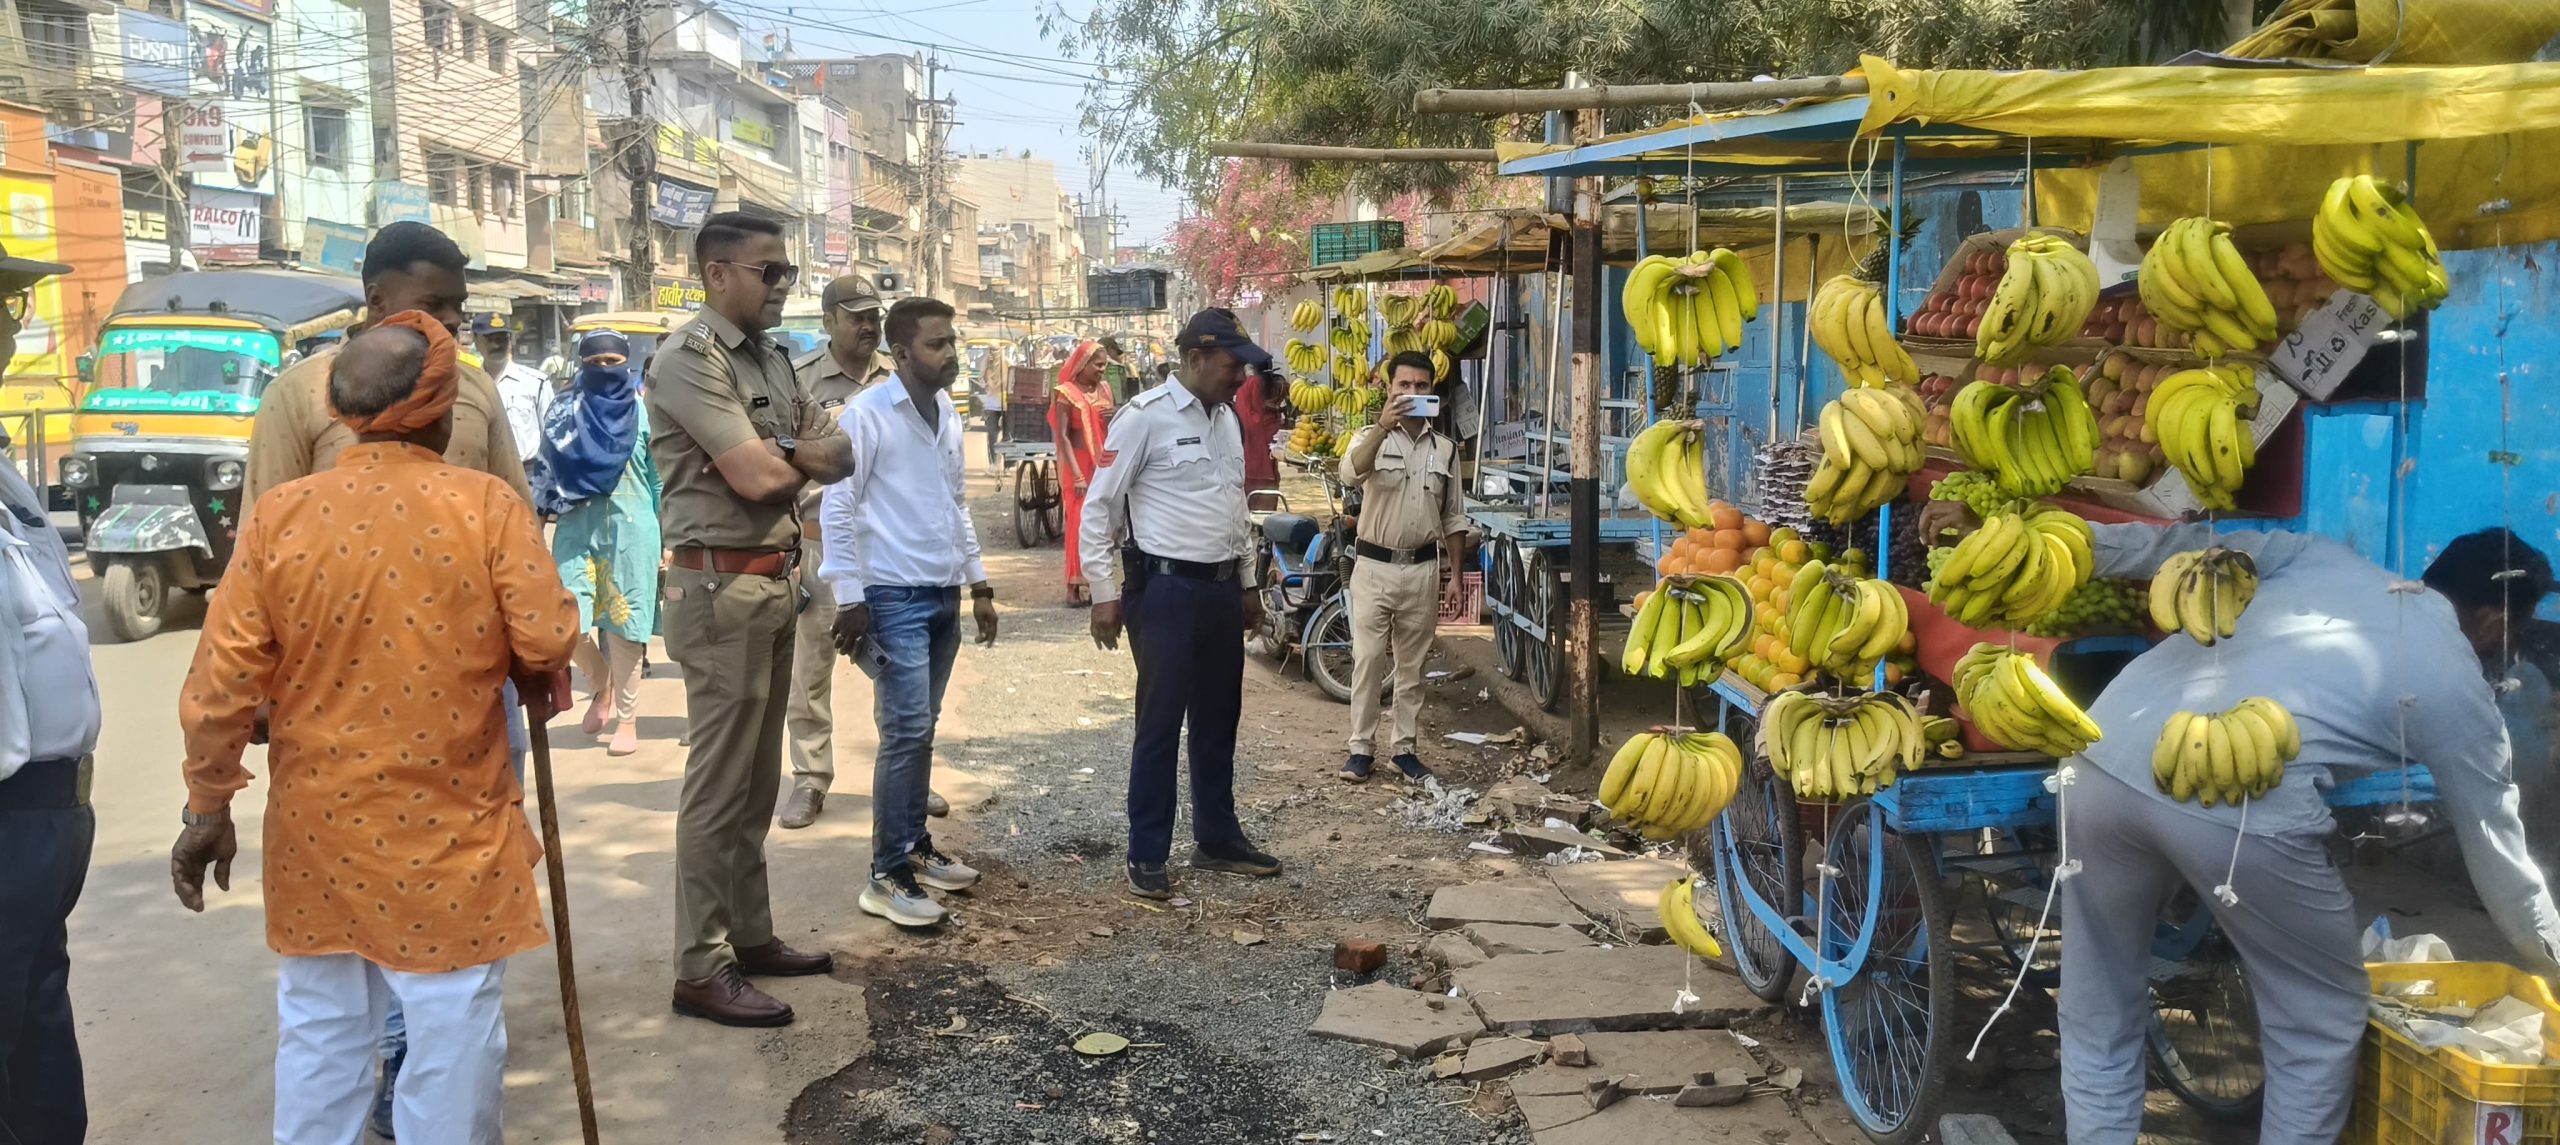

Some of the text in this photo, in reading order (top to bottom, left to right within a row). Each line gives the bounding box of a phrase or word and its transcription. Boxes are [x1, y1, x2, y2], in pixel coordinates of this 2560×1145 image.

[128, 34, 183, 67] EPSON
[184, 133, 223, 146] COMPUTER
[194, 207, 238, 225] RALCO
[2485, 1112, 2511, 1145] R
